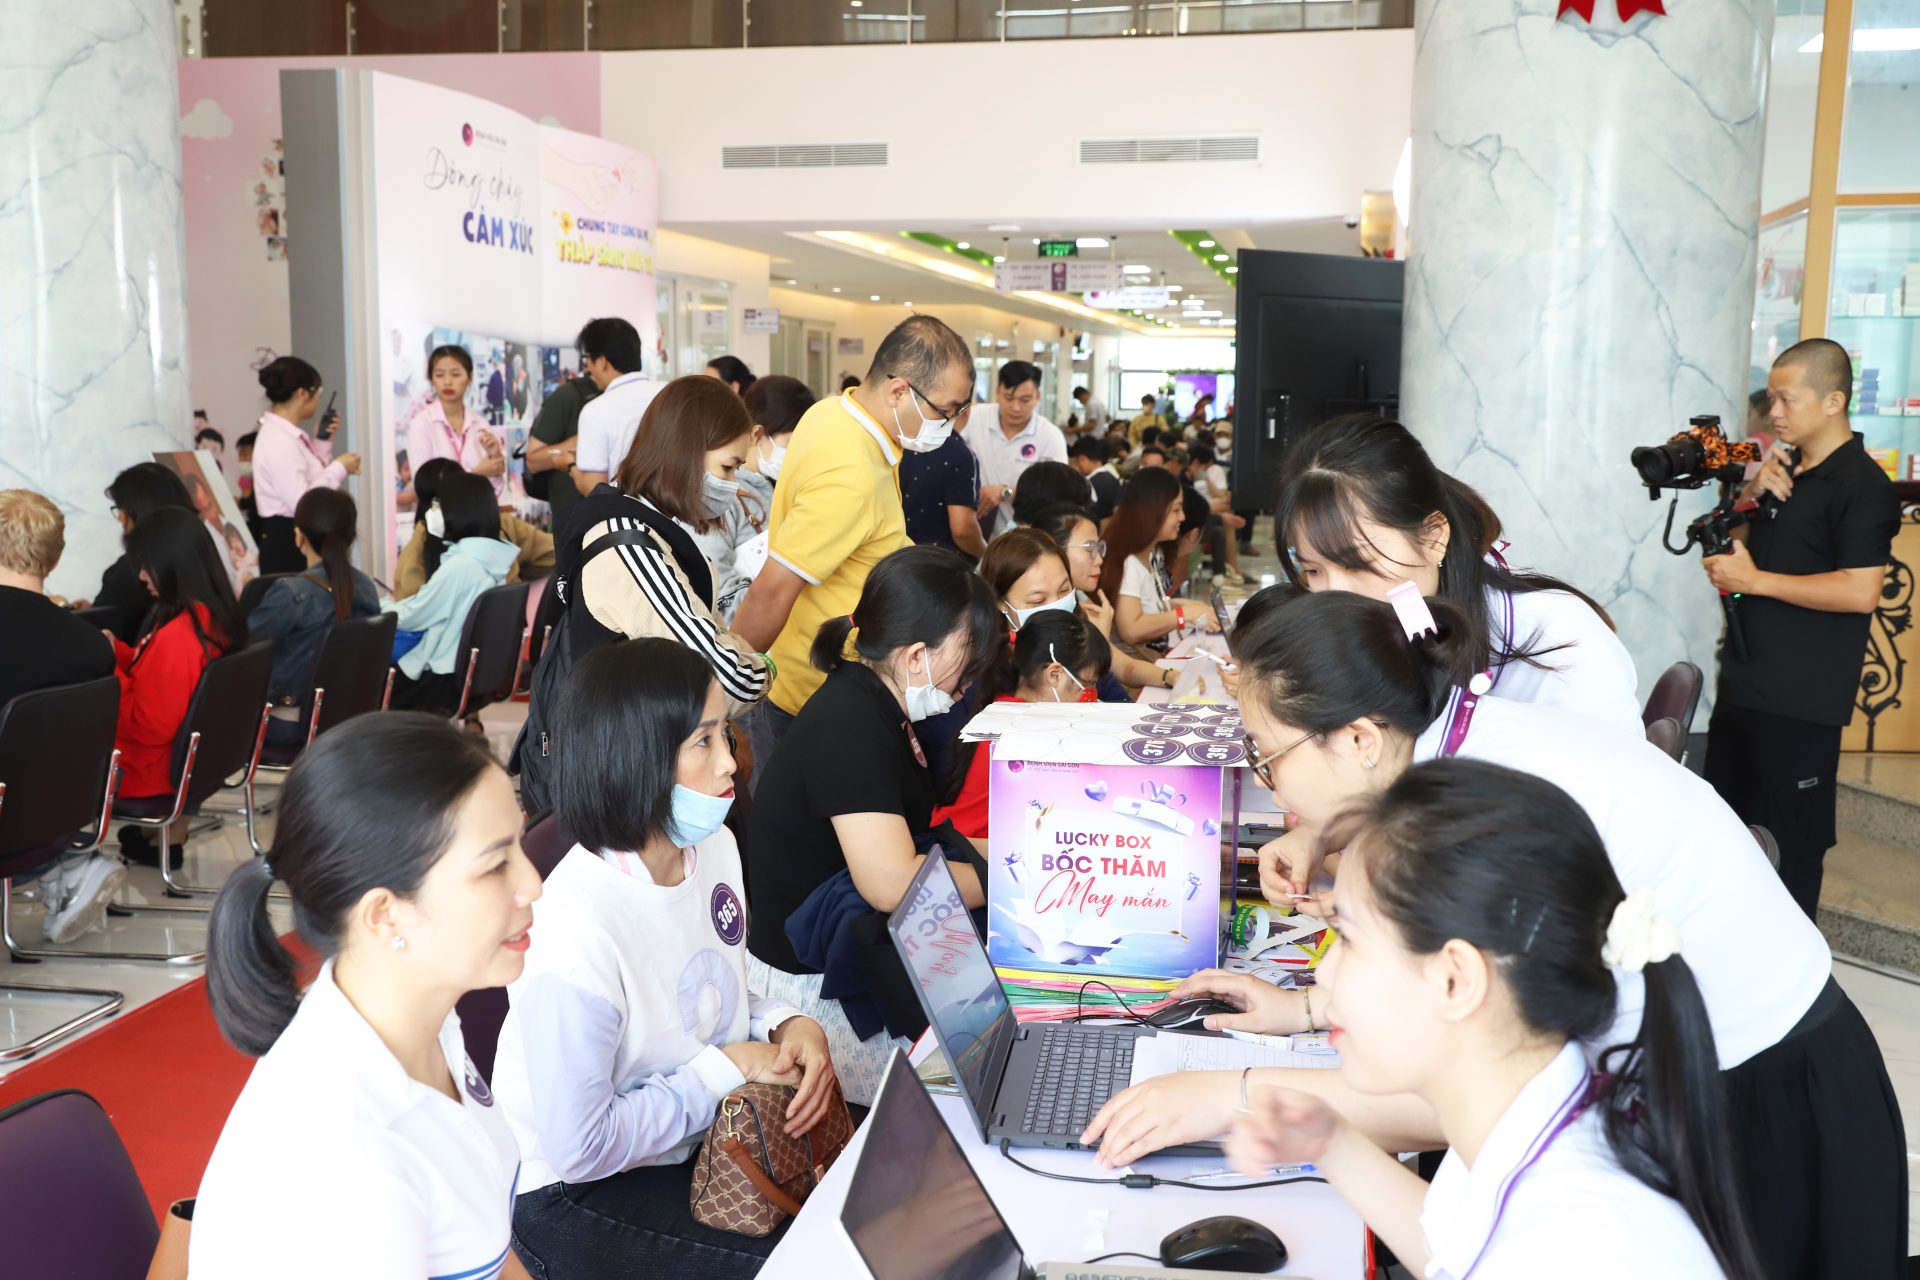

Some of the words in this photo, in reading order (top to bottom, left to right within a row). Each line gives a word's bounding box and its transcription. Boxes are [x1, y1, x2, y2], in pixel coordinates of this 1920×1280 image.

[463, 205, 504, 248] CẢM
[1142, 740, 1167, 756] 376
[1206, 744, 1230, 760] 391
[1055, 831, 1109, 847] LUCKY
[1115, 834, 1152, 849] BOX
[1041, 848, 1093, 873] BỐC
[1100, 854, 1167, 878] THĂM
[1034, 869, 1117, 917] May
[1122, 888, 1172, 908] mắn
[717, 896, 737, 931] 365
